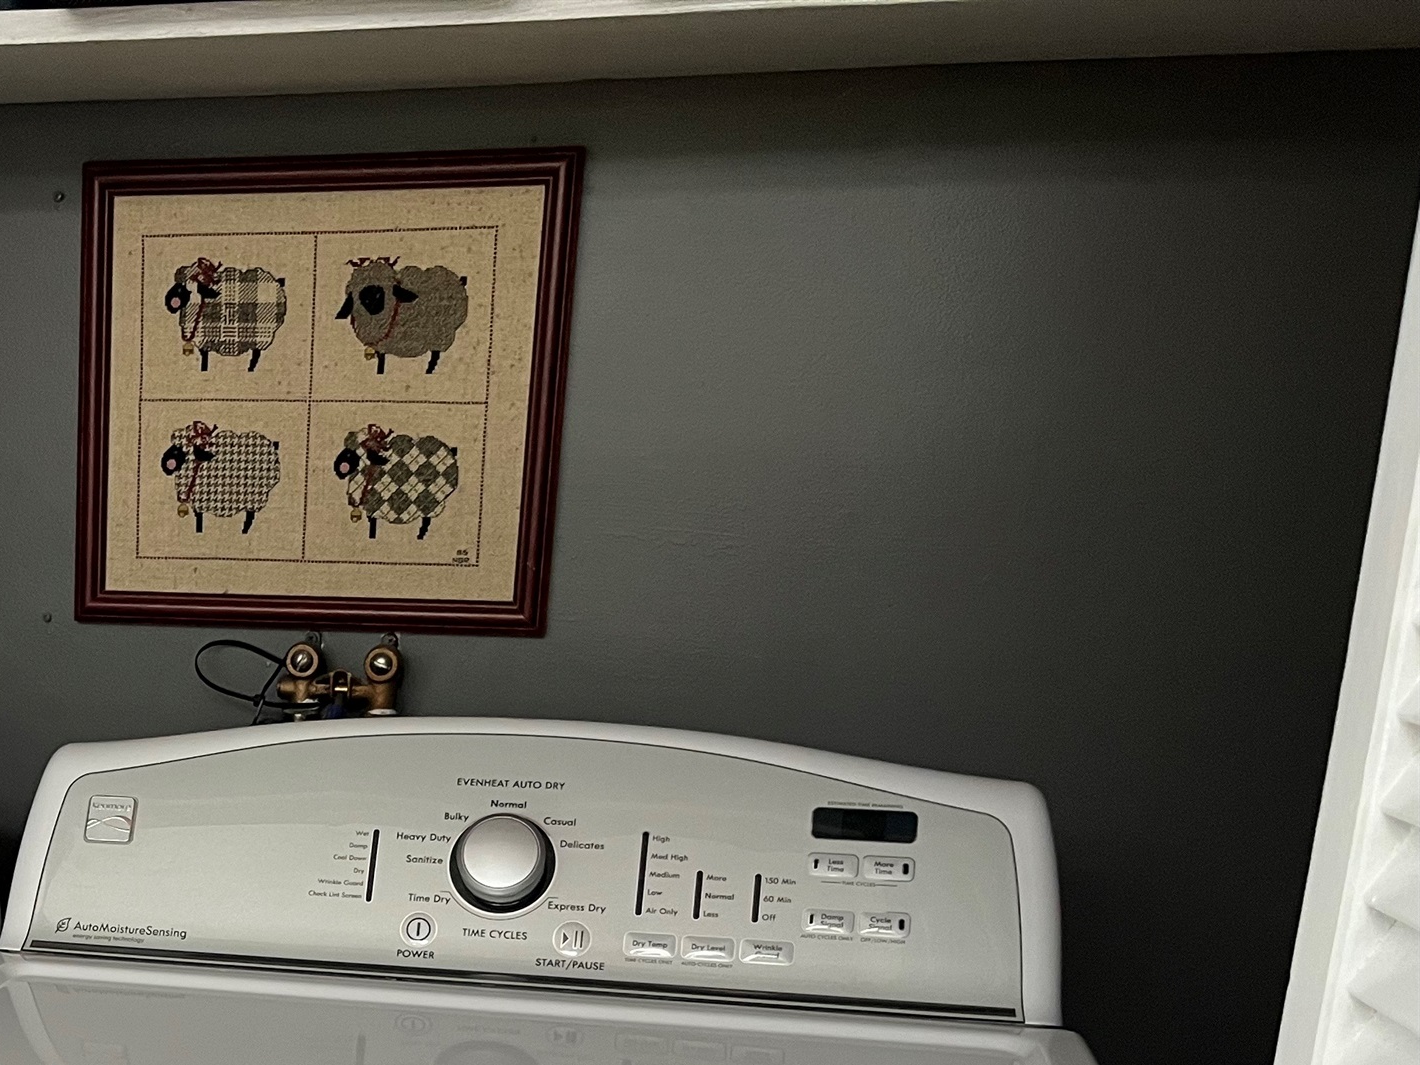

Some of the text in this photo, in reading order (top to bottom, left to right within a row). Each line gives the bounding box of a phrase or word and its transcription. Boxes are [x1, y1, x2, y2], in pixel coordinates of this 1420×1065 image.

[457, 778, 566, 790] EVENHEAT AUTO DRY
[490, 800, 527, 809] Normal
[444, 812, 470, 822] Bulky
[544, 817, 577, 826] Casual
[396, 832, 452, 844] Heavy Duty
[652, 835, 670, 844] High
[348, 842, 368, 850] Damp
[560, 840, 605, 850] Delicates
[406, 854, 444, 864] Sanitize
[670, 854, 688, 862] High
[828, 858, 844, 866] Less
[649, 871, 680, 879] Medium
[706, 874, 727, 882] More
[318, 878, 342, 886] Wrinkle
[765, 877, 796, 886] 150 Min
[647, 888, 663, 896] Low
[704, 892, 735, 900] Normal
[408, 893, 451, 905] Time Dry
[776, 896, 792, 904] Min
[548, 901, 607, 914] Express Dry
[659, 908, 678, 916] Only
[762, 914, 776, 922] Off
[820, 914, 844, 922] Damp
[870, 916, 892, 924] Cycle
[74, 921, 188, 940] AutoMoistureSensing
[462, 928, 528, 940] TIME CYCLES
[632, 940, 668, 949] Dry Temp
[691, 943, 726, 952] Dry Level
[397, 950, 435, 960] POWER
[536, 958, 605, 971] START/PAUSE
